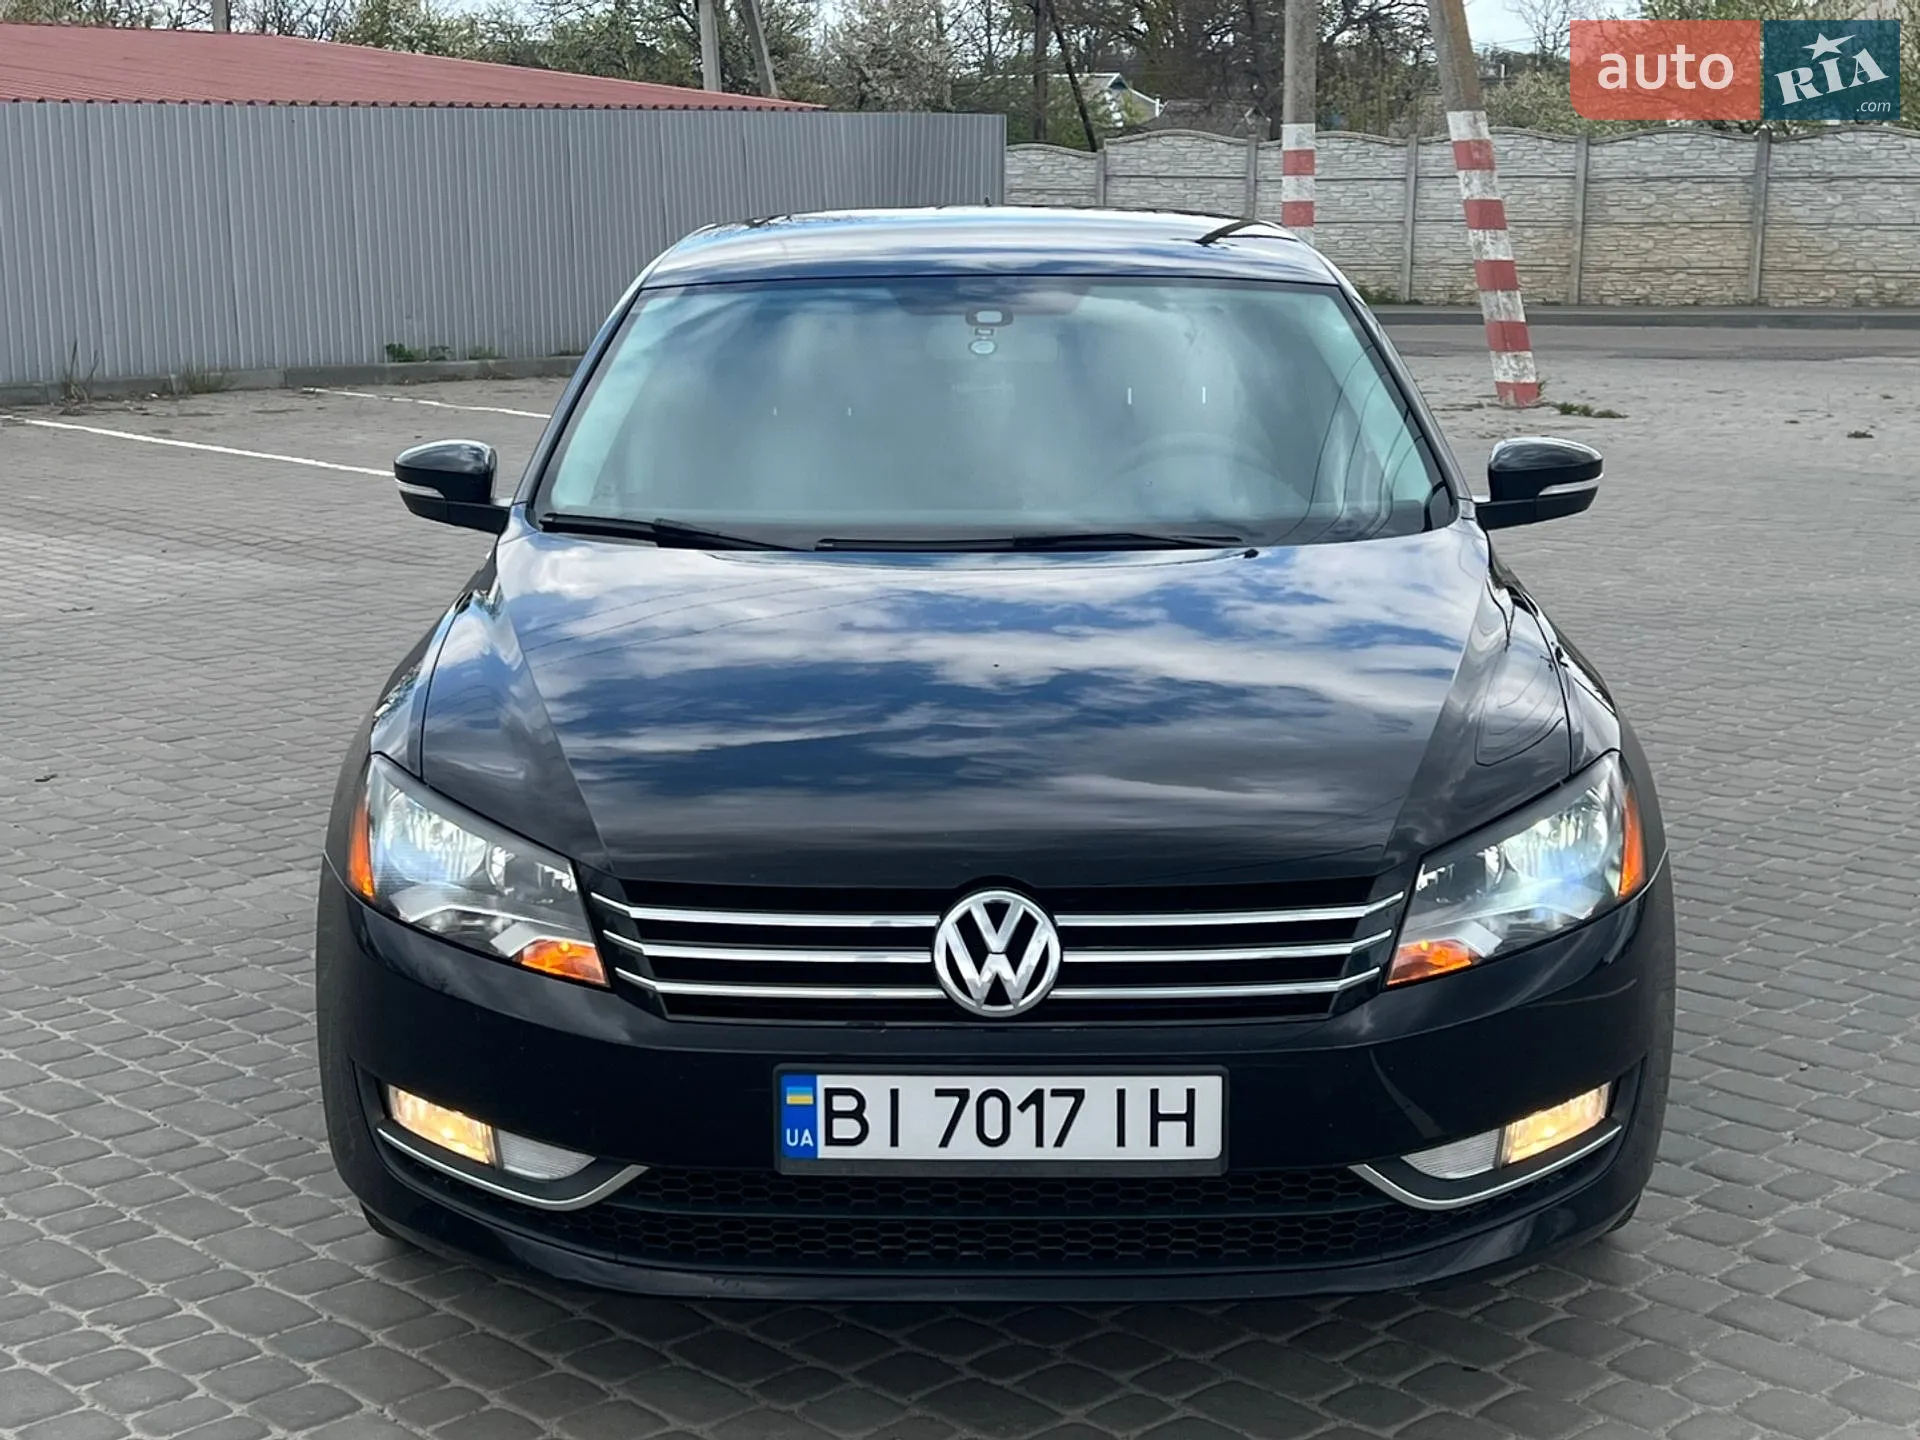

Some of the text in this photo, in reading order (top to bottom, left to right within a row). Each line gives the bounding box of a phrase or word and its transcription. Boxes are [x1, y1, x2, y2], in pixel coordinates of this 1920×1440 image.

[938, 893, 1056, 1013] VW
[786, 1128, 814, 1147] UA
[824, 1087, 1196, 1148] BI 7017 IH
